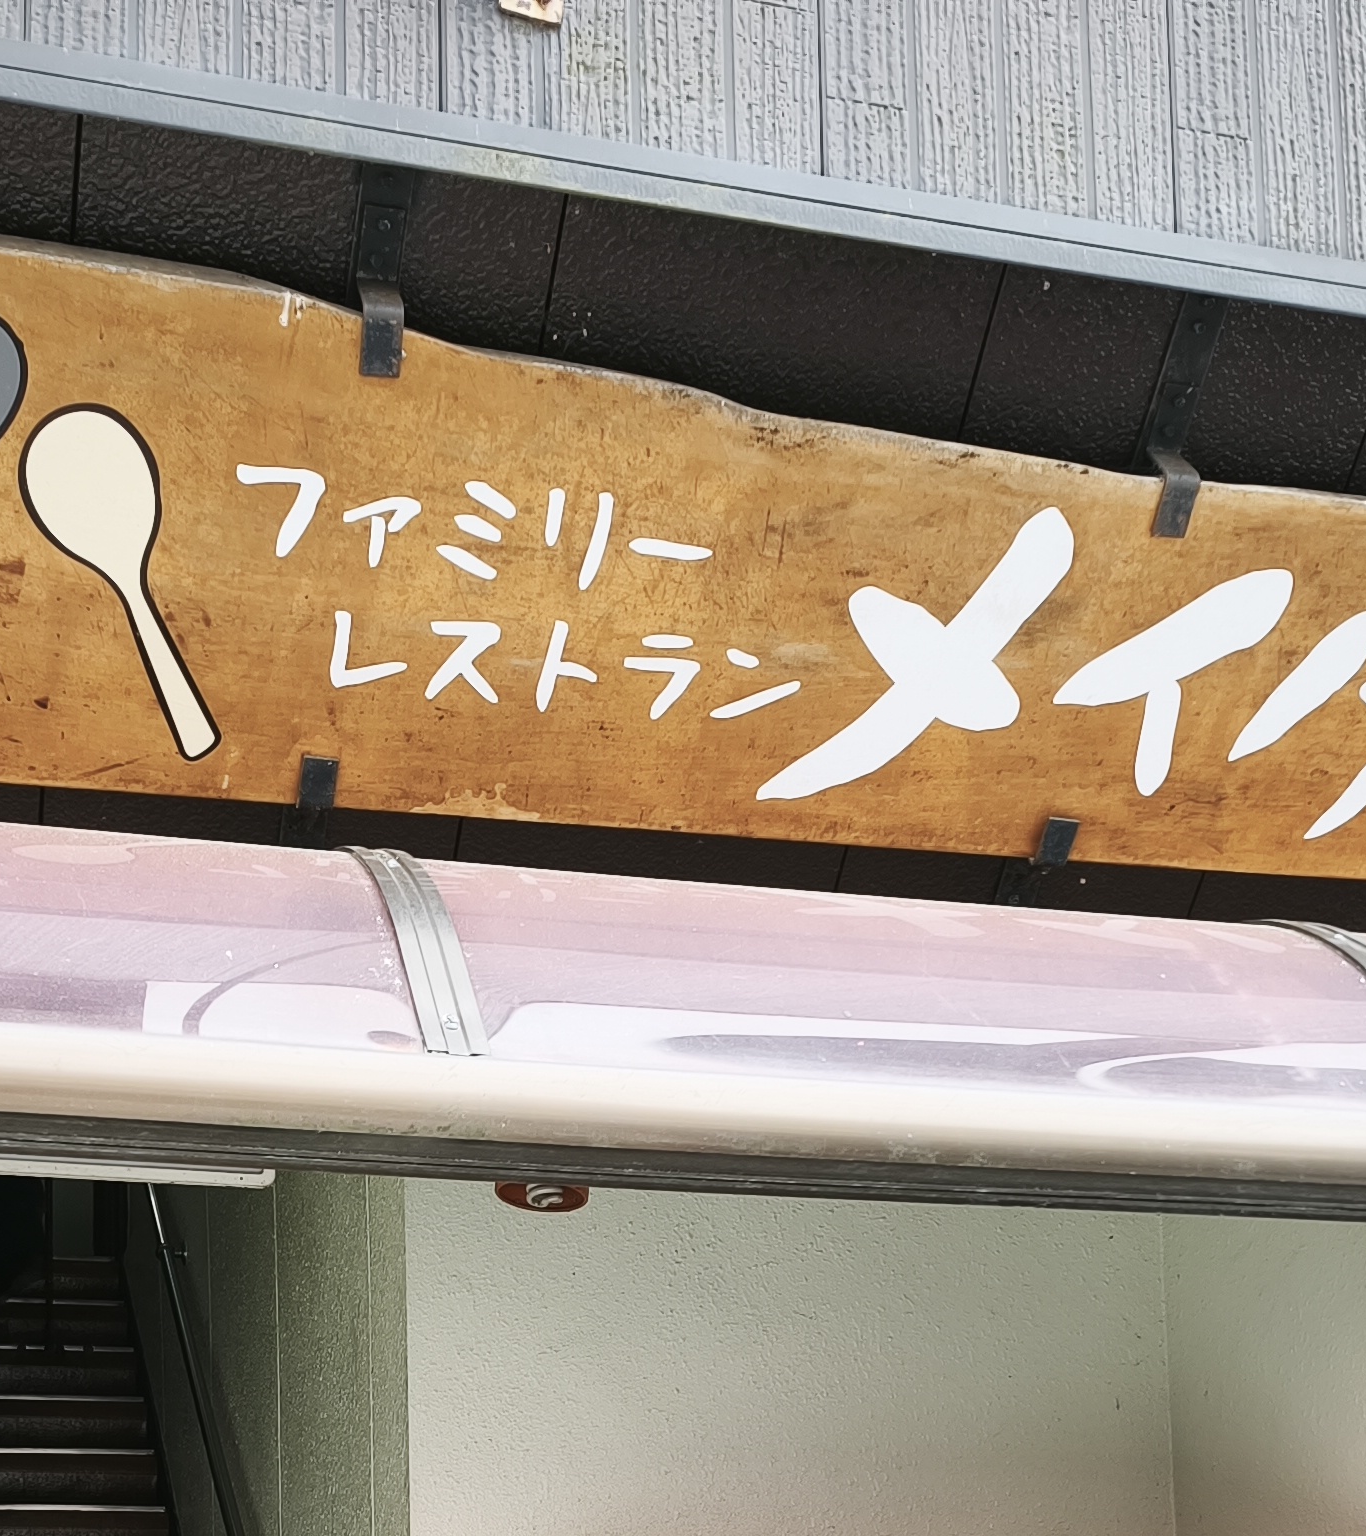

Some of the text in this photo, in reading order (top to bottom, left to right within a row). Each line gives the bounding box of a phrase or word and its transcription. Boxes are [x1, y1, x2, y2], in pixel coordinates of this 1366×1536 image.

[237, 463, 713, 590] ファミリー
[329, 610, 801, 720] レストラン
